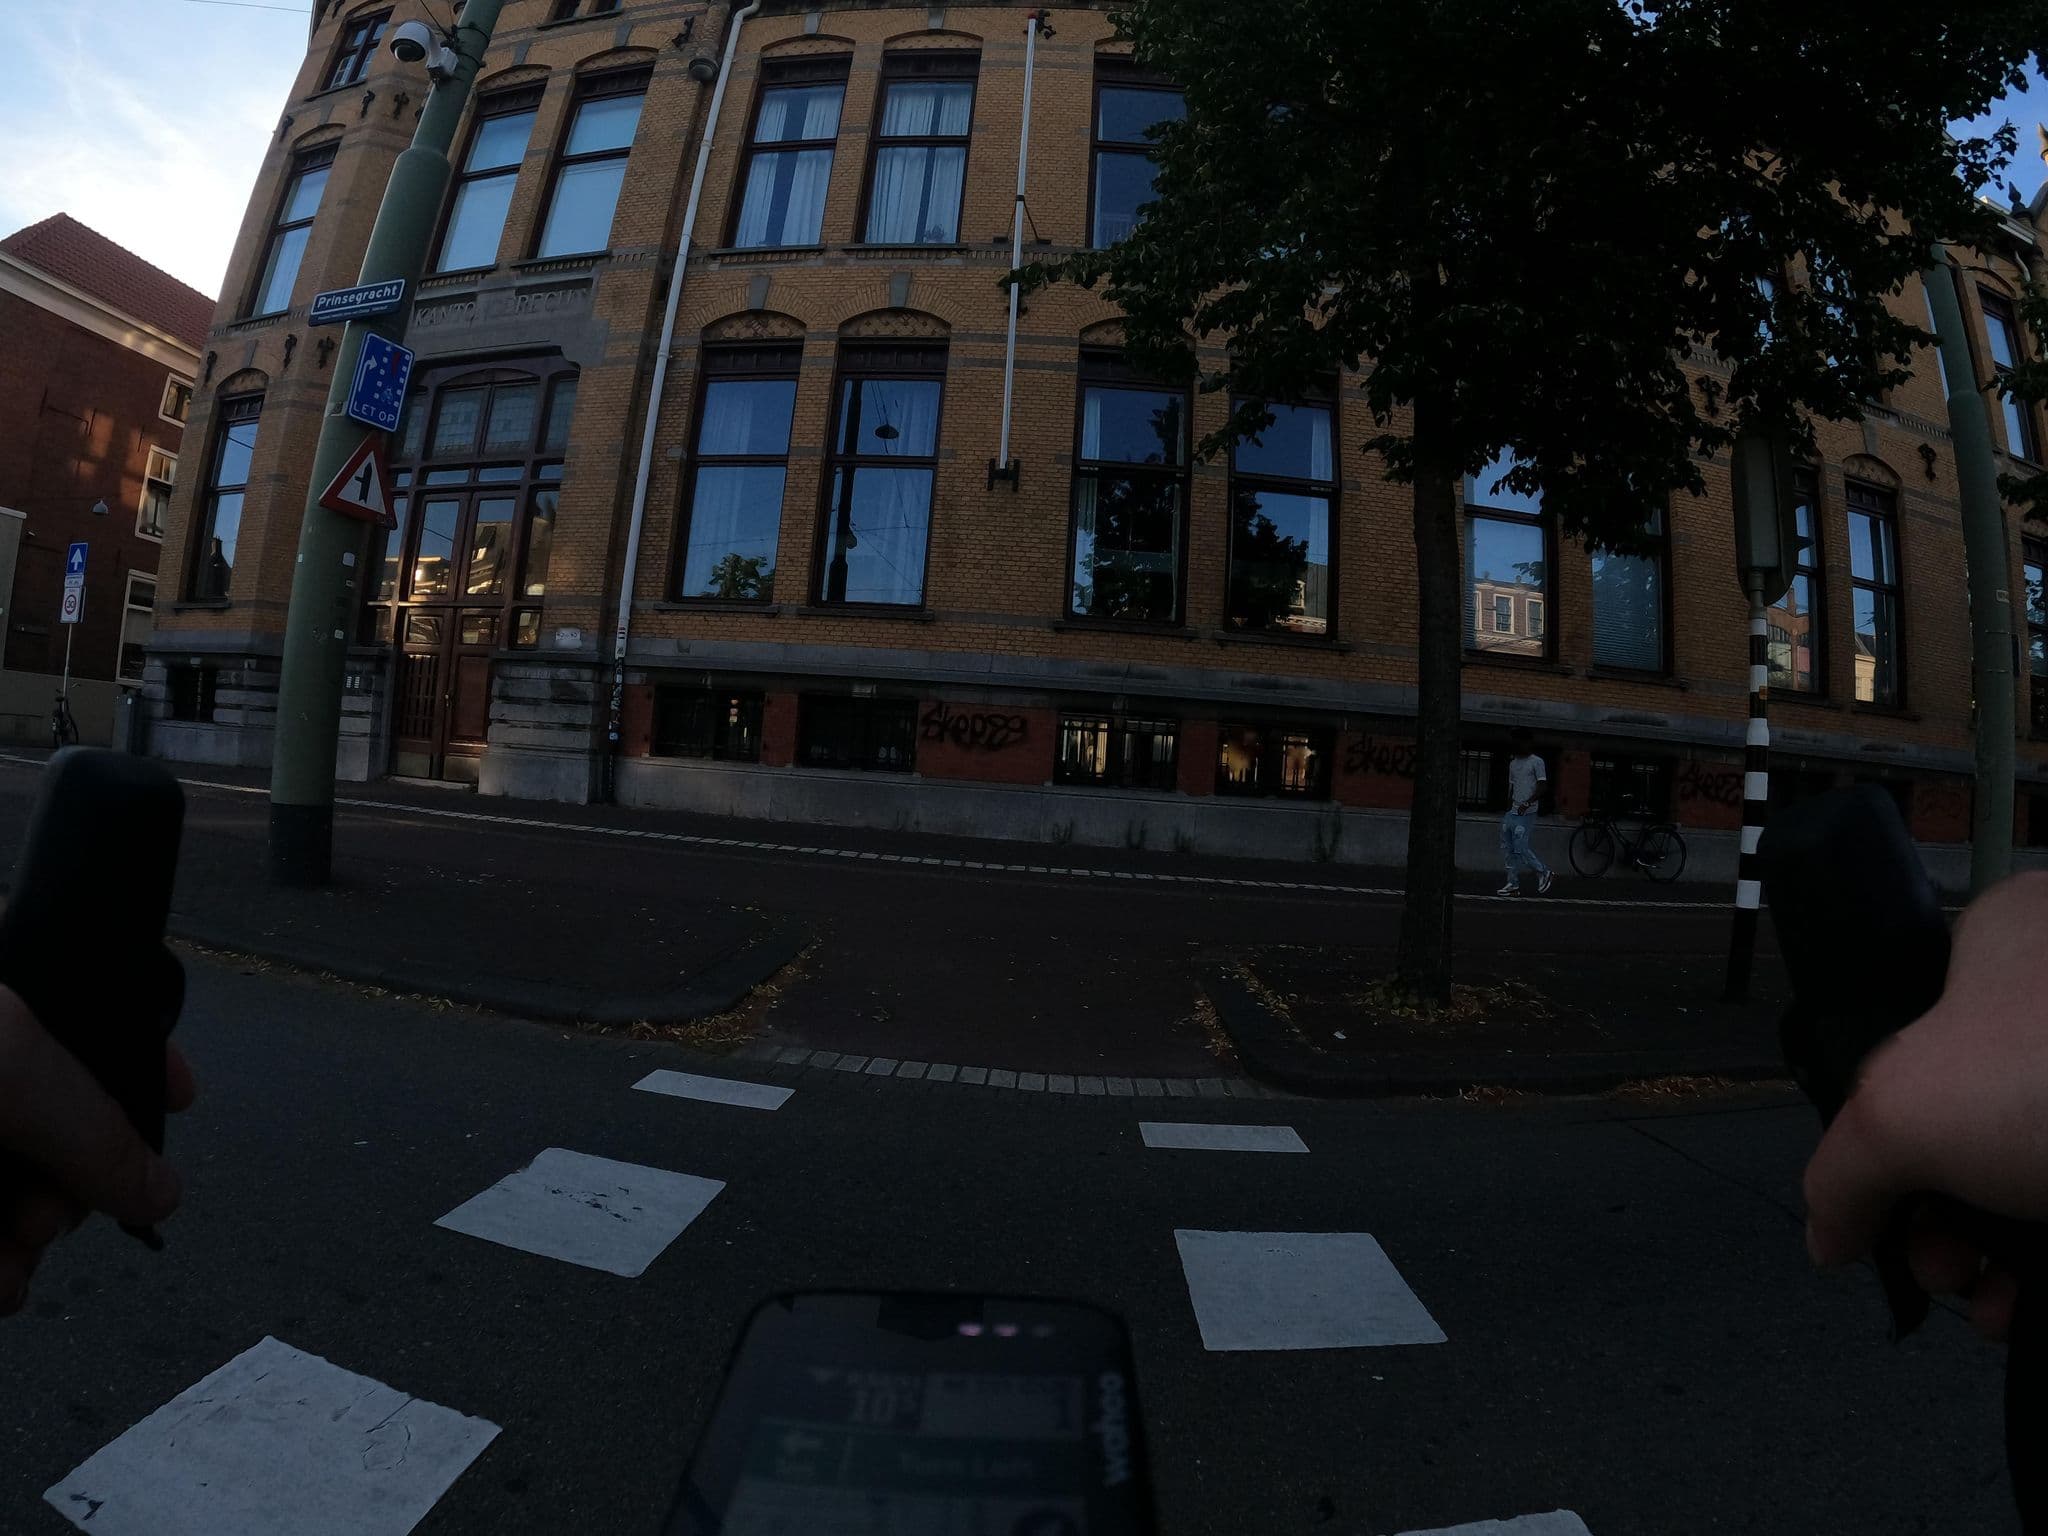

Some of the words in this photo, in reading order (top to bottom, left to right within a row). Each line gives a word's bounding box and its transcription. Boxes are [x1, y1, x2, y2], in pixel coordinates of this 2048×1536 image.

[317, 285, 398, 309] Prinsegracht
[352, 401, 376, 417] LET
[379, 409, 396, 424] OP
